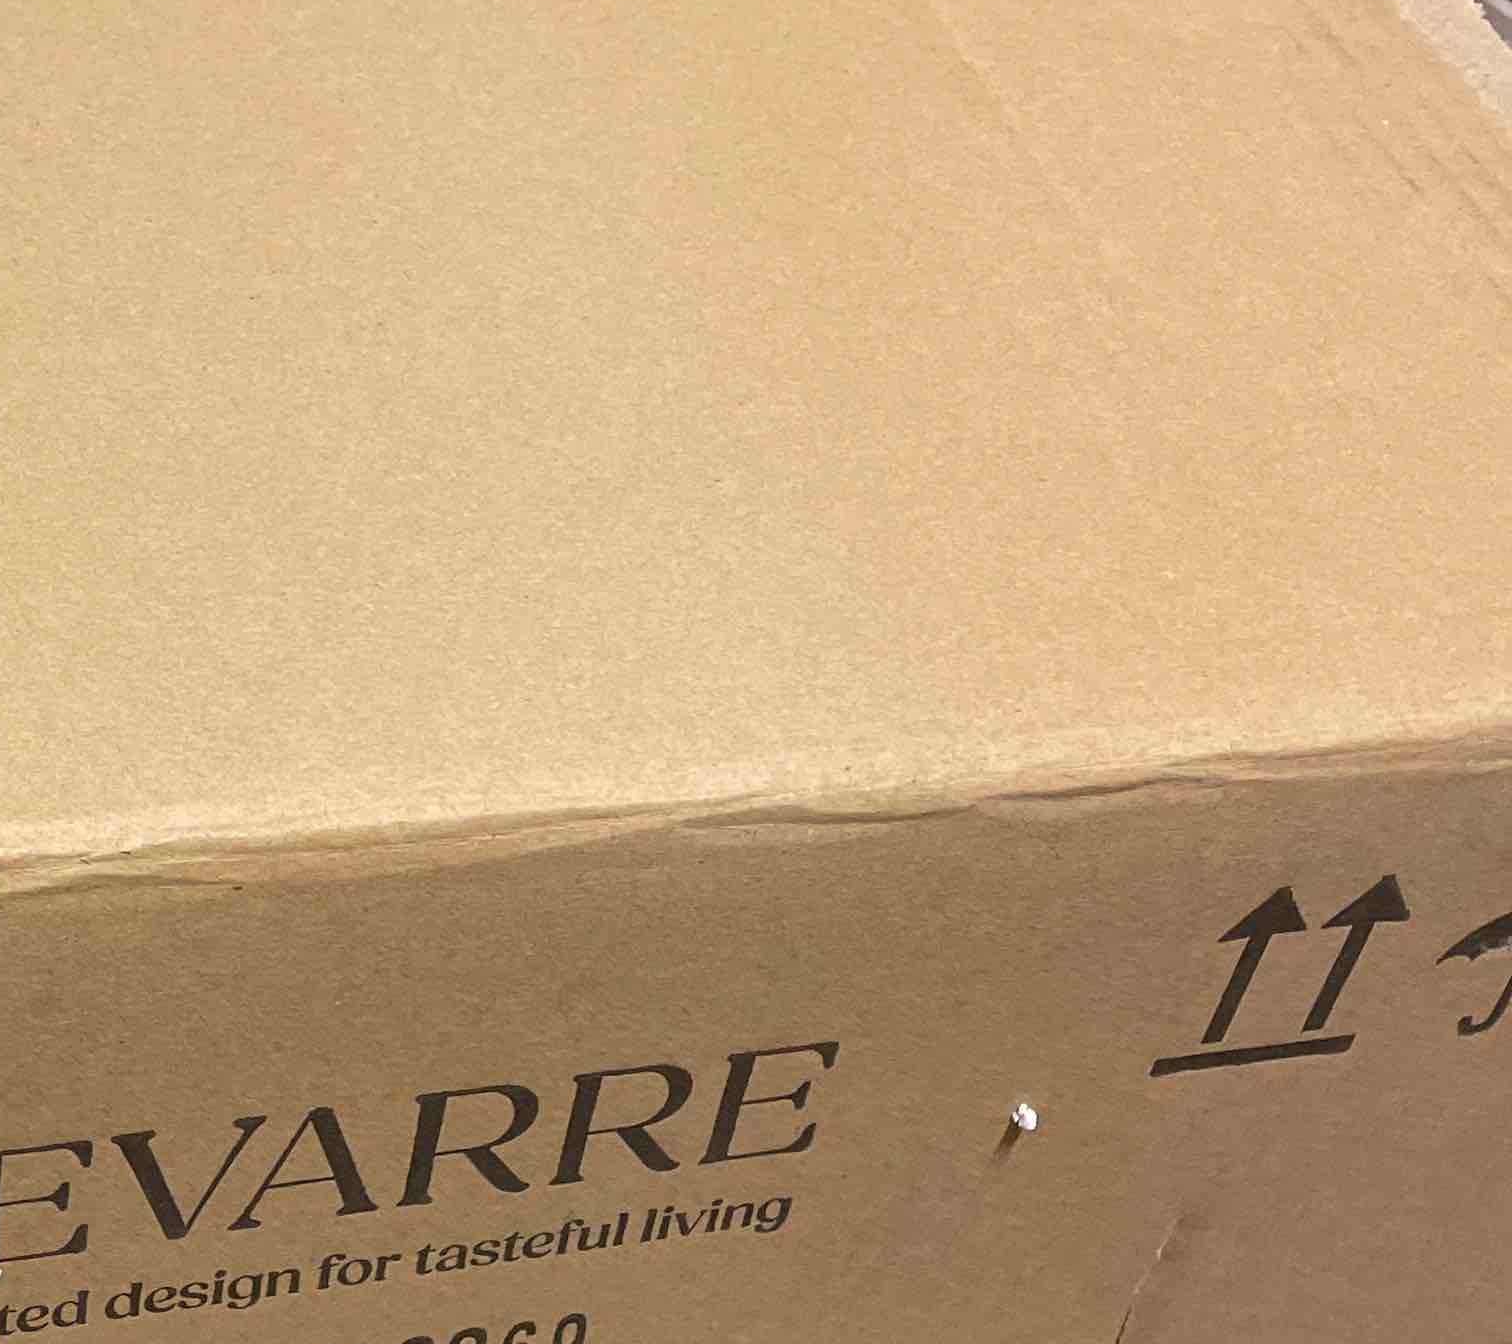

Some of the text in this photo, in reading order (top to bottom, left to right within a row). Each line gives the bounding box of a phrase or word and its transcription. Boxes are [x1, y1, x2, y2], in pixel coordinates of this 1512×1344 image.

[111, 1264, 298, 1329] design
[316, 1243, 403, 1291] for
[414, 1210, 628, 1278] tasteful
[640, 1189, 792, 1240] living
